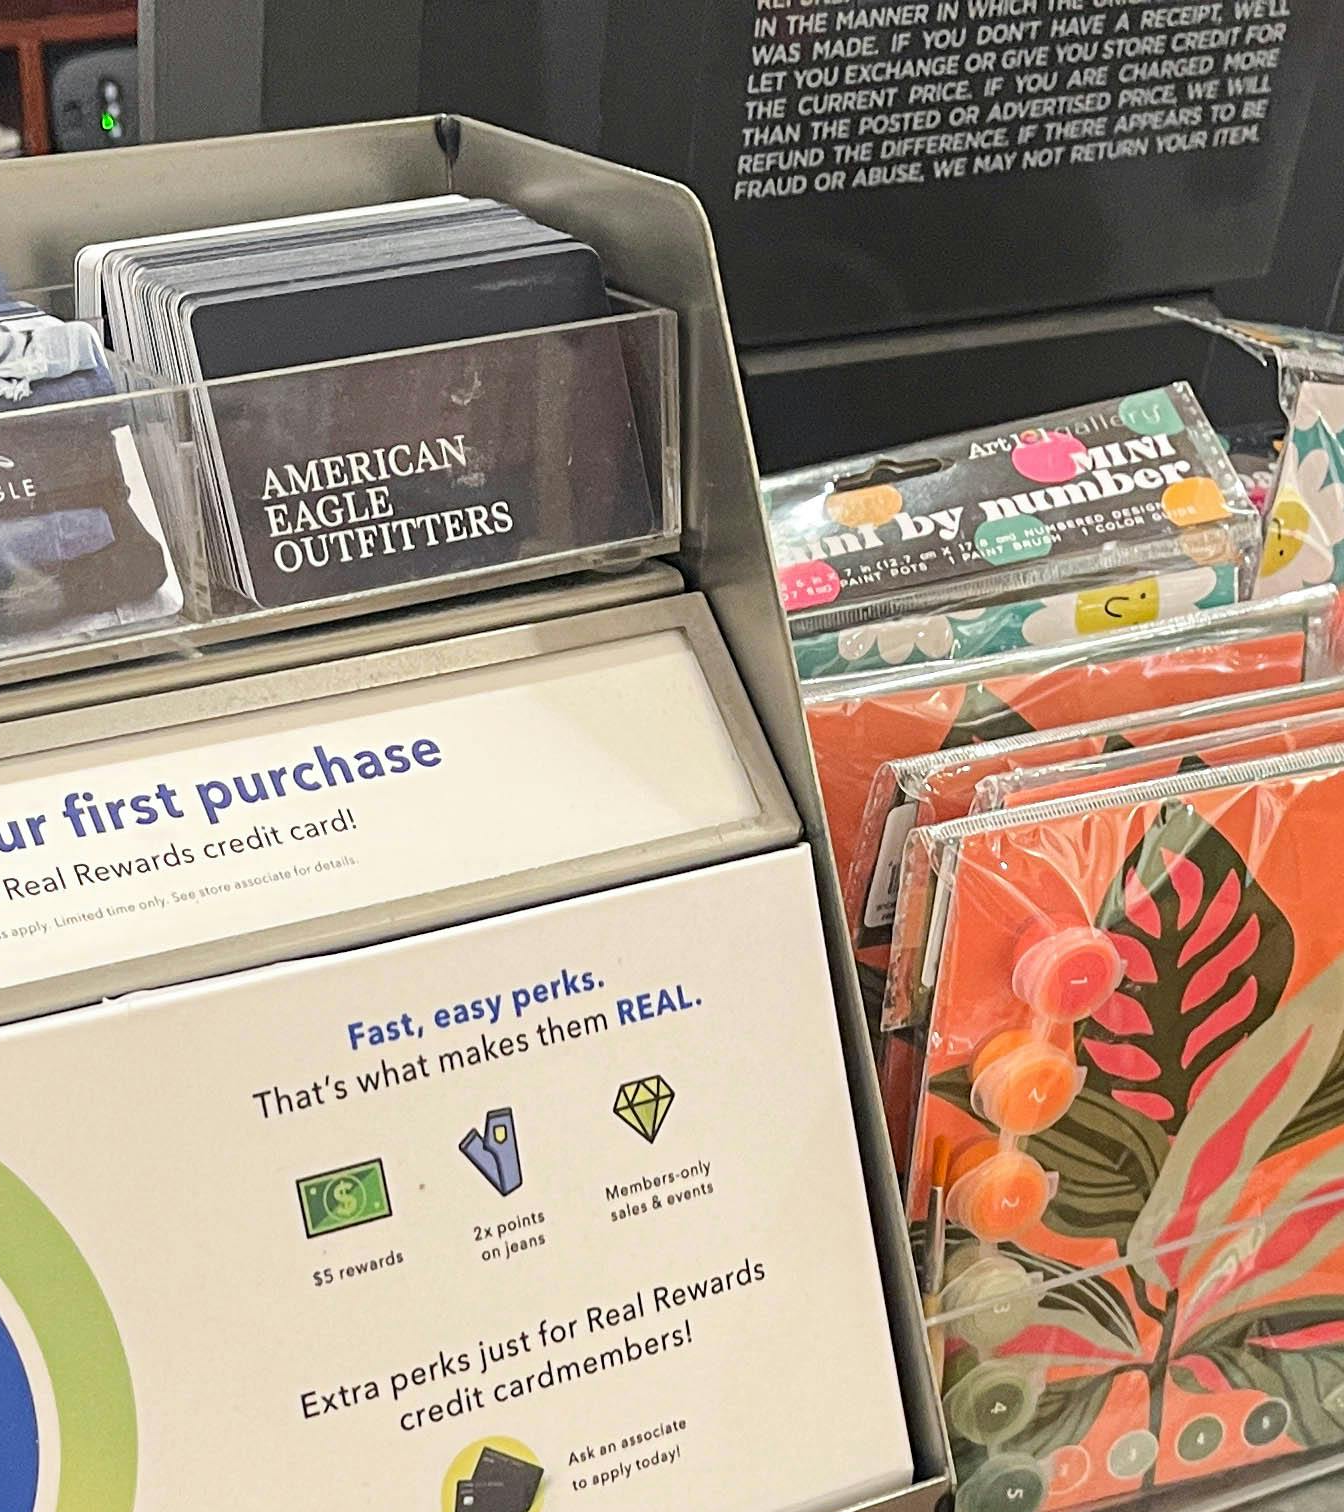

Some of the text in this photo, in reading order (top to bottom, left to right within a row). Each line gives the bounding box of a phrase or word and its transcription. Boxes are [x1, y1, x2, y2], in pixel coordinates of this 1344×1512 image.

[751, 42, 800, 65] WAS
[890, 31, 910, 52] IF
[922, 27, 966, 49] YOU
[1050, 13, 1106, 37] HAVE
[1114, 11, 1129, 32] A
[754, 15, 776, 38] IN
[785, 12, 828, 35] THE
[835, 4, 929, 30] MANNER
[936, 1, 958, 21] IN
[745, 97, 786, 120] THE
[798, 86, 898, 115] CURRENT
[983, 76, 1004, 96] IF
[1015, 71, 1057, 93] YOU
[1066, 65, 1108, 89] ARE
[1118, 55, 1213, 83] CHARGED
[1223, 47, 1280, 72] MORE
[747, 22, 1286, 93] LET YOU EXCHANGE OR GIVE YOU STORE CREDIT FOR
[737, 147, 824, 174] REFUND
[833, 141, 873, 163] THE
[1017, 124, 1038, 144] IF
[1044, 116, 1107, 141] THERE
[741, 91, 1111, 147] THAN THE POSTED OR ADVERTISED
[734, 146, 1065, 200] FRAUD OR WE MAY NOT
[261, 434, 468, 500] AMERICAN
[1069, 433, 1176, 475] MINI
[264, 486, 394, 538] EAGLE
[895, 460, 1191, 540] by number
[1024, 514, 1105, 541] NUMBERED
[273, 501, 513, 572] OUTFITTERS
[961, 544, 1004, 561] PAINT
[61, 782, 185, 838] first
[194, 737, 442, 825] purchase
[1, 865, 67, 901] Real
[72, 841, 195, 886] Rewards
[202, 824, 284, 859] credit
[289, 807, 357, 841] card!
[52, 906, 104, 928] Limited
[104, 903, 136, 917] time
[169, 890, 198, 904] See
[197, 883, 231, 898] store
[233, 869, 292, 890] associate
[292, 863, 311, 877] for
[346, 967, 605, 1051] Fast, easy perks.
[251, 983, 702, 1119] That's what makes them REAL.
[604, 1158, 711, 1201] Members-only
[609, 1182, 714, 1223] sales & events
[472, 1211, 545, 1242] 2x points
[480, 1233, 546, 1262] on jeans
[311, 1249, 404, 1287] $5 rewards
[299, 1257, 765, 1420] Extra perks just for Real Rewards
[399, 1318, 692, 1431] credit cardmembers!
[567, 1419, 687, 1467] Ask an associate
[571, 1443, 681, 1492] to apply today!
